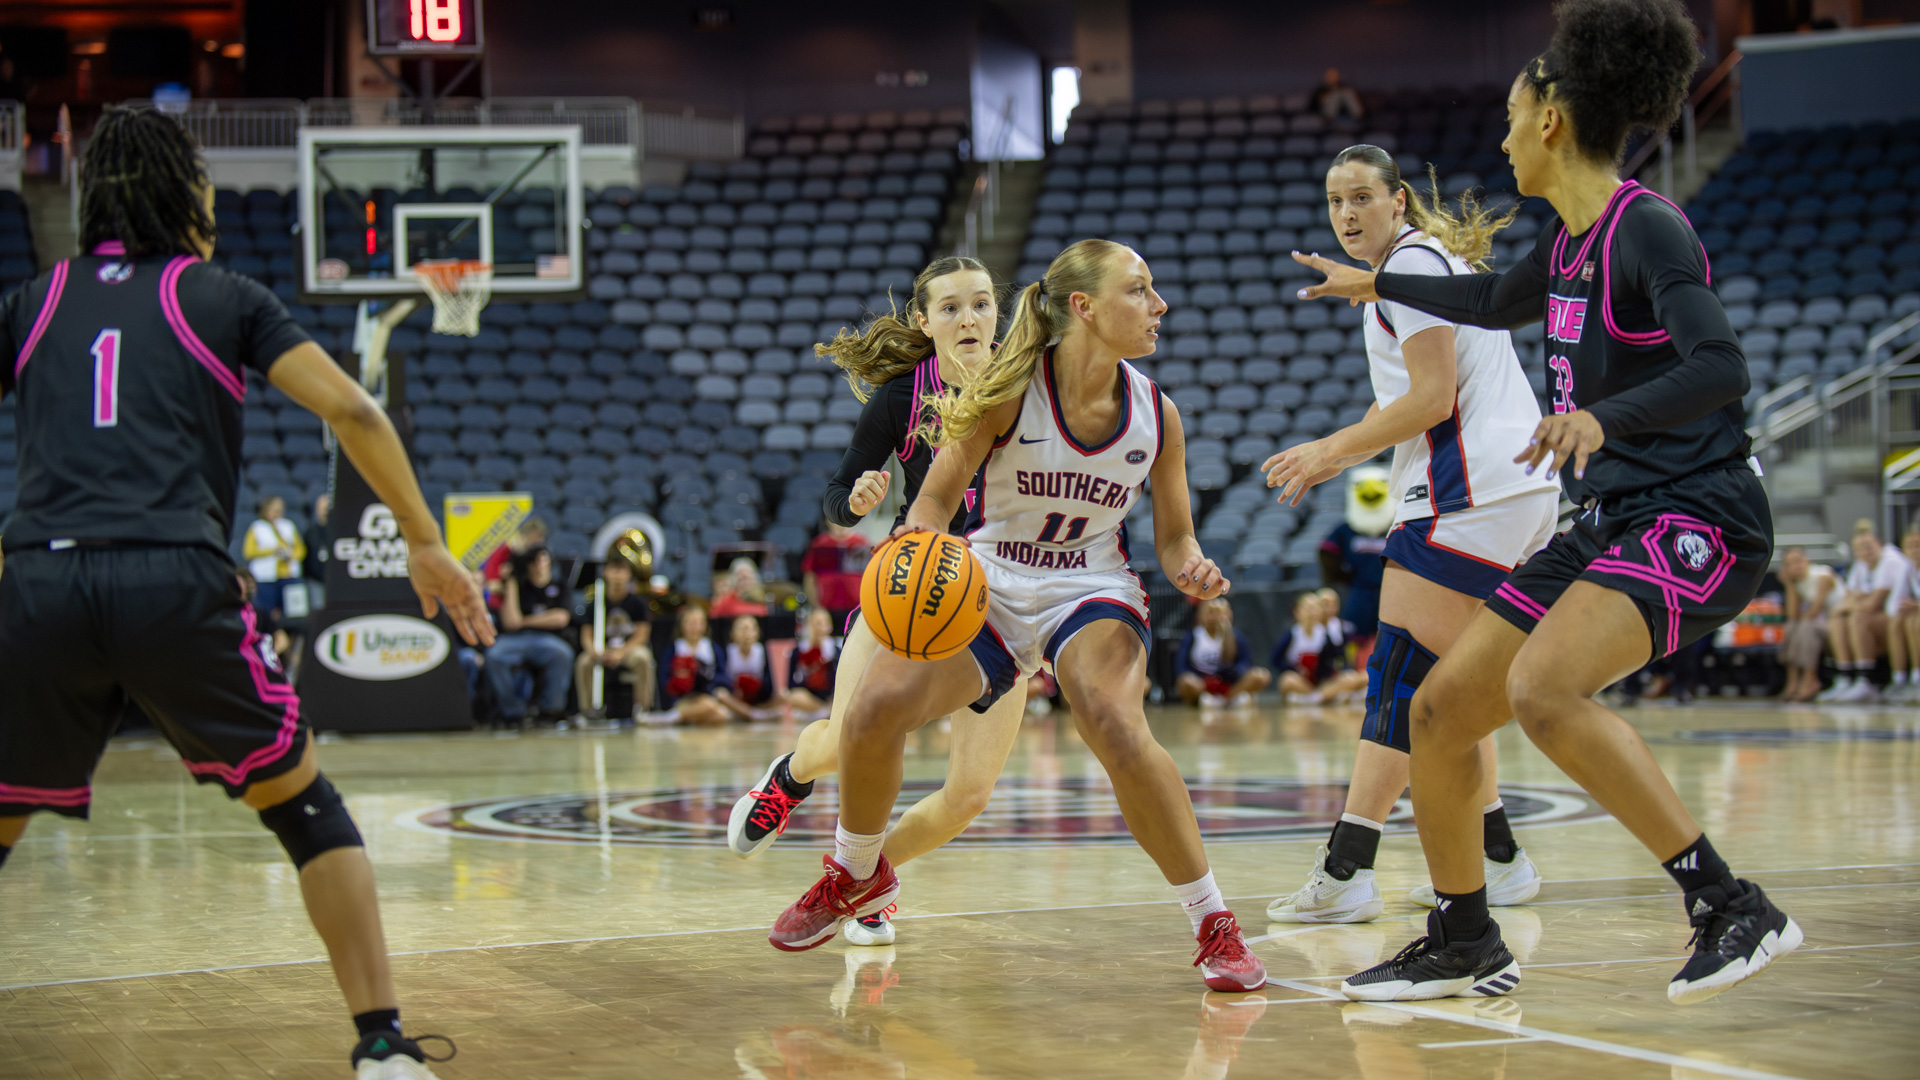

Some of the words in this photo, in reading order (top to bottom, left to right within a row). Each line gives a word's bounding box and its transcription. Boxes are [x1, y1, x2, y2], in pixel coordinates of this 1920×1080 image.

[410, 0, 460, 41] 18
[90, 328, 121, 428] 1
[1016, 470, 1130, 509] SOUTHERN
[1036, 512, 1089, 545] 11
[889, 540, 920, 596] NCAA
[996, 541, 1087, 569] INDIANA
[920, 541, 962, 617] Wilson
[381, 649, 431, 664] BANK
